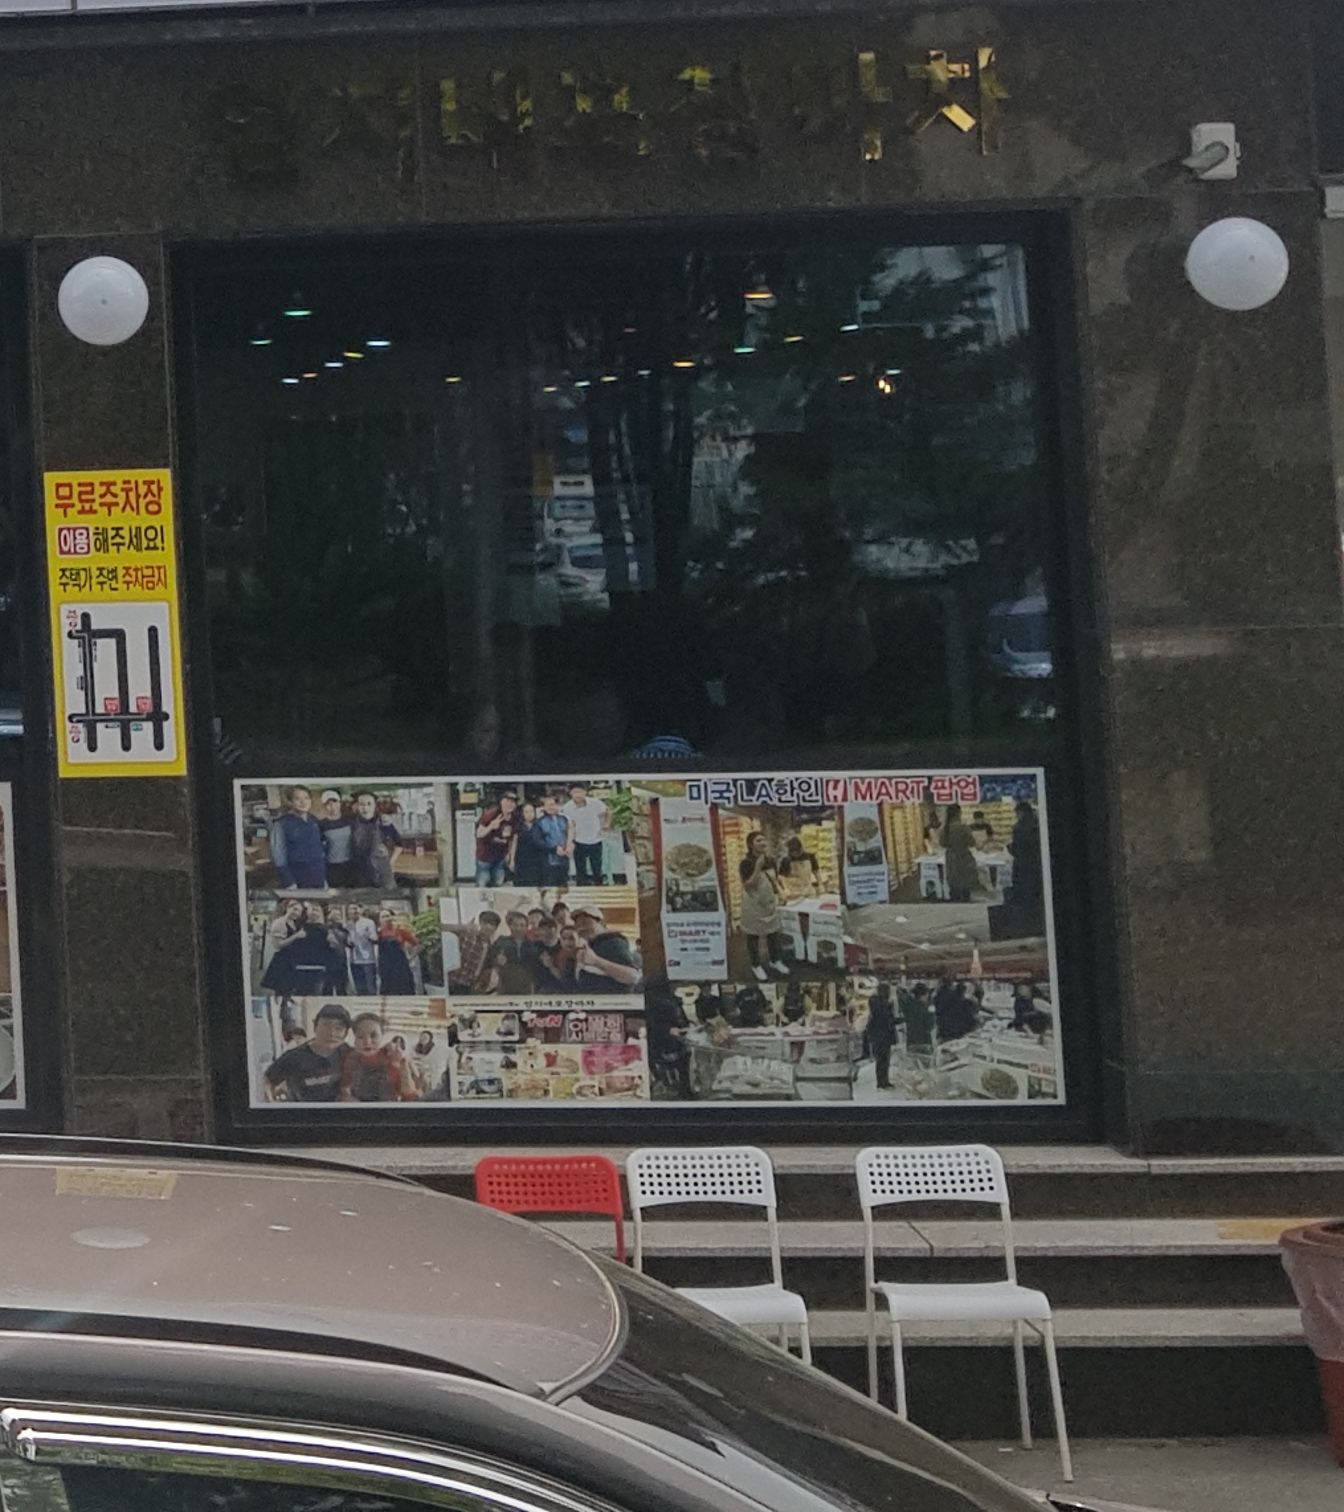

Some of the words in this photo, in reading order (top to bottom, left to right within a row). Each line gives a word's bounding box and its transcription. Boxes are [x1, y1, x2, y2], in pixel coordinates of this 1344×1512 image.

[55, 478, 163, 518] 무료주차장
[60, 529, 88, 553] 이용
[93, 525, 164, 554] 해주세요!
[59, 566, 92, 592] 주택가
[96, 566, 118, 591] 주변
[122, 565, 167, 590] 주차금지
[687, 780, 734, 804] 미국
[739, 779, 821, 804] LA한인
[852, 779, 928, 802] MART
